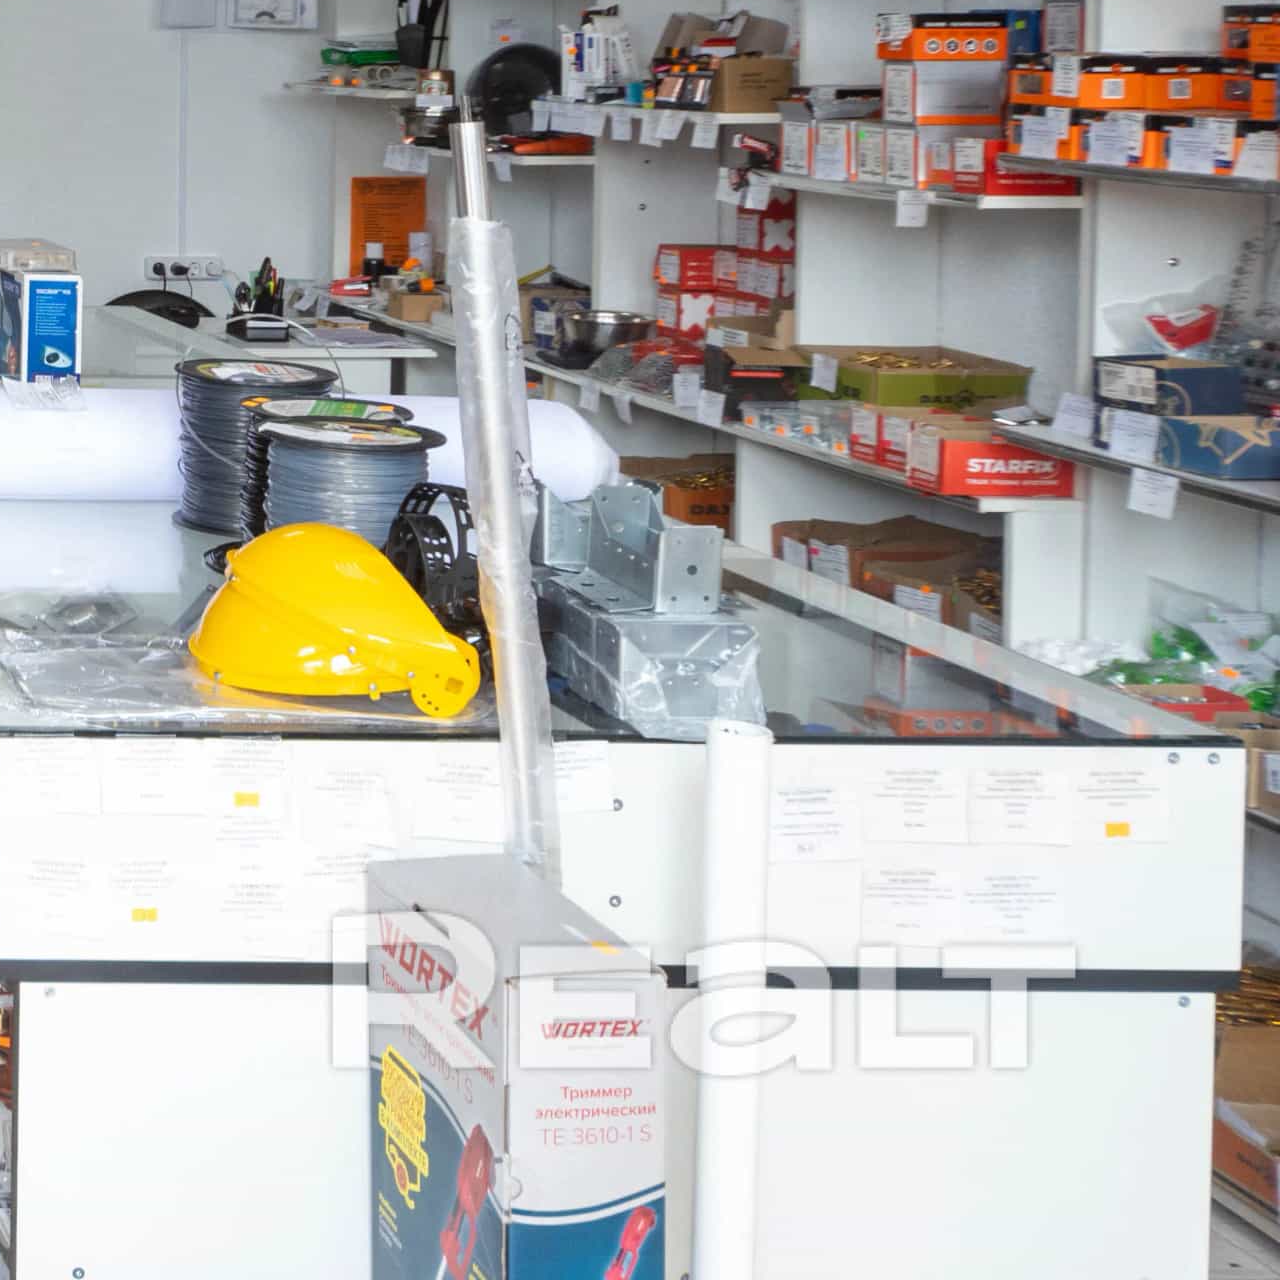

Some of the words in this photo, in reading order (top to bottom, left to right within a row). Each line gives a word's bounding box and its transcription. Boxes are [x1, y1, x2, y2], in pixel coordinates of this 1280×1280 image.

[965, 457, 1057, 474] STARFIX
[541, 1018, 645, 1039] WORTEX
[559, 1085, 633, 1103] Триммер
[535, 1103, 657, 1121] электрический
[537, 1127, 568, 1145] TE
[574, 1125, 634, 1145] 3610-1
[639, 1123, 652, 1143] S
